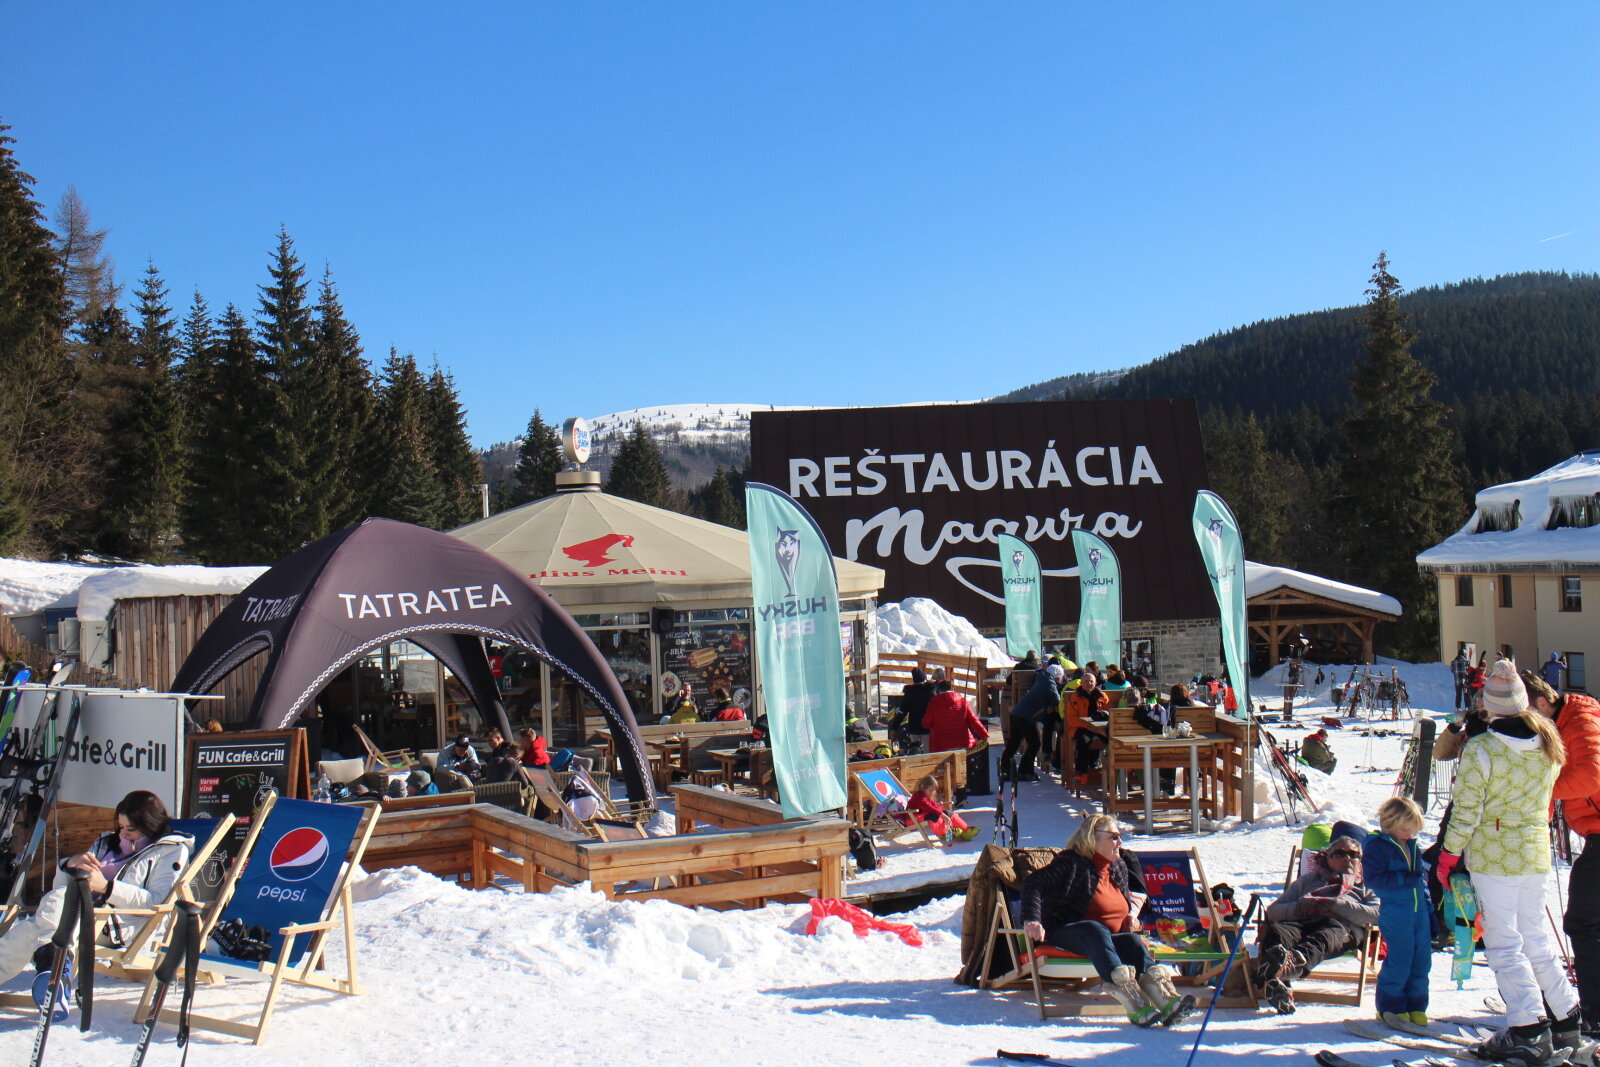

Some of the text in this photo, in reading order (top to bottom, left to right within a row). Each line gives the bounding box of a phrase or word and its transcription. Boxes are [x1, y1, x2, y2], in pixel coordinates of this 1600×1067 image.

[789, 440, 1163, 497] REŠTAURÁCIA
[608, 567, 688, 577] Meinl
[338, 583, 513, 619] TATRATEA
[197, 748, 285, 764] FUN Cafe&Grill
[256, 885, 307, 902] pepsi
